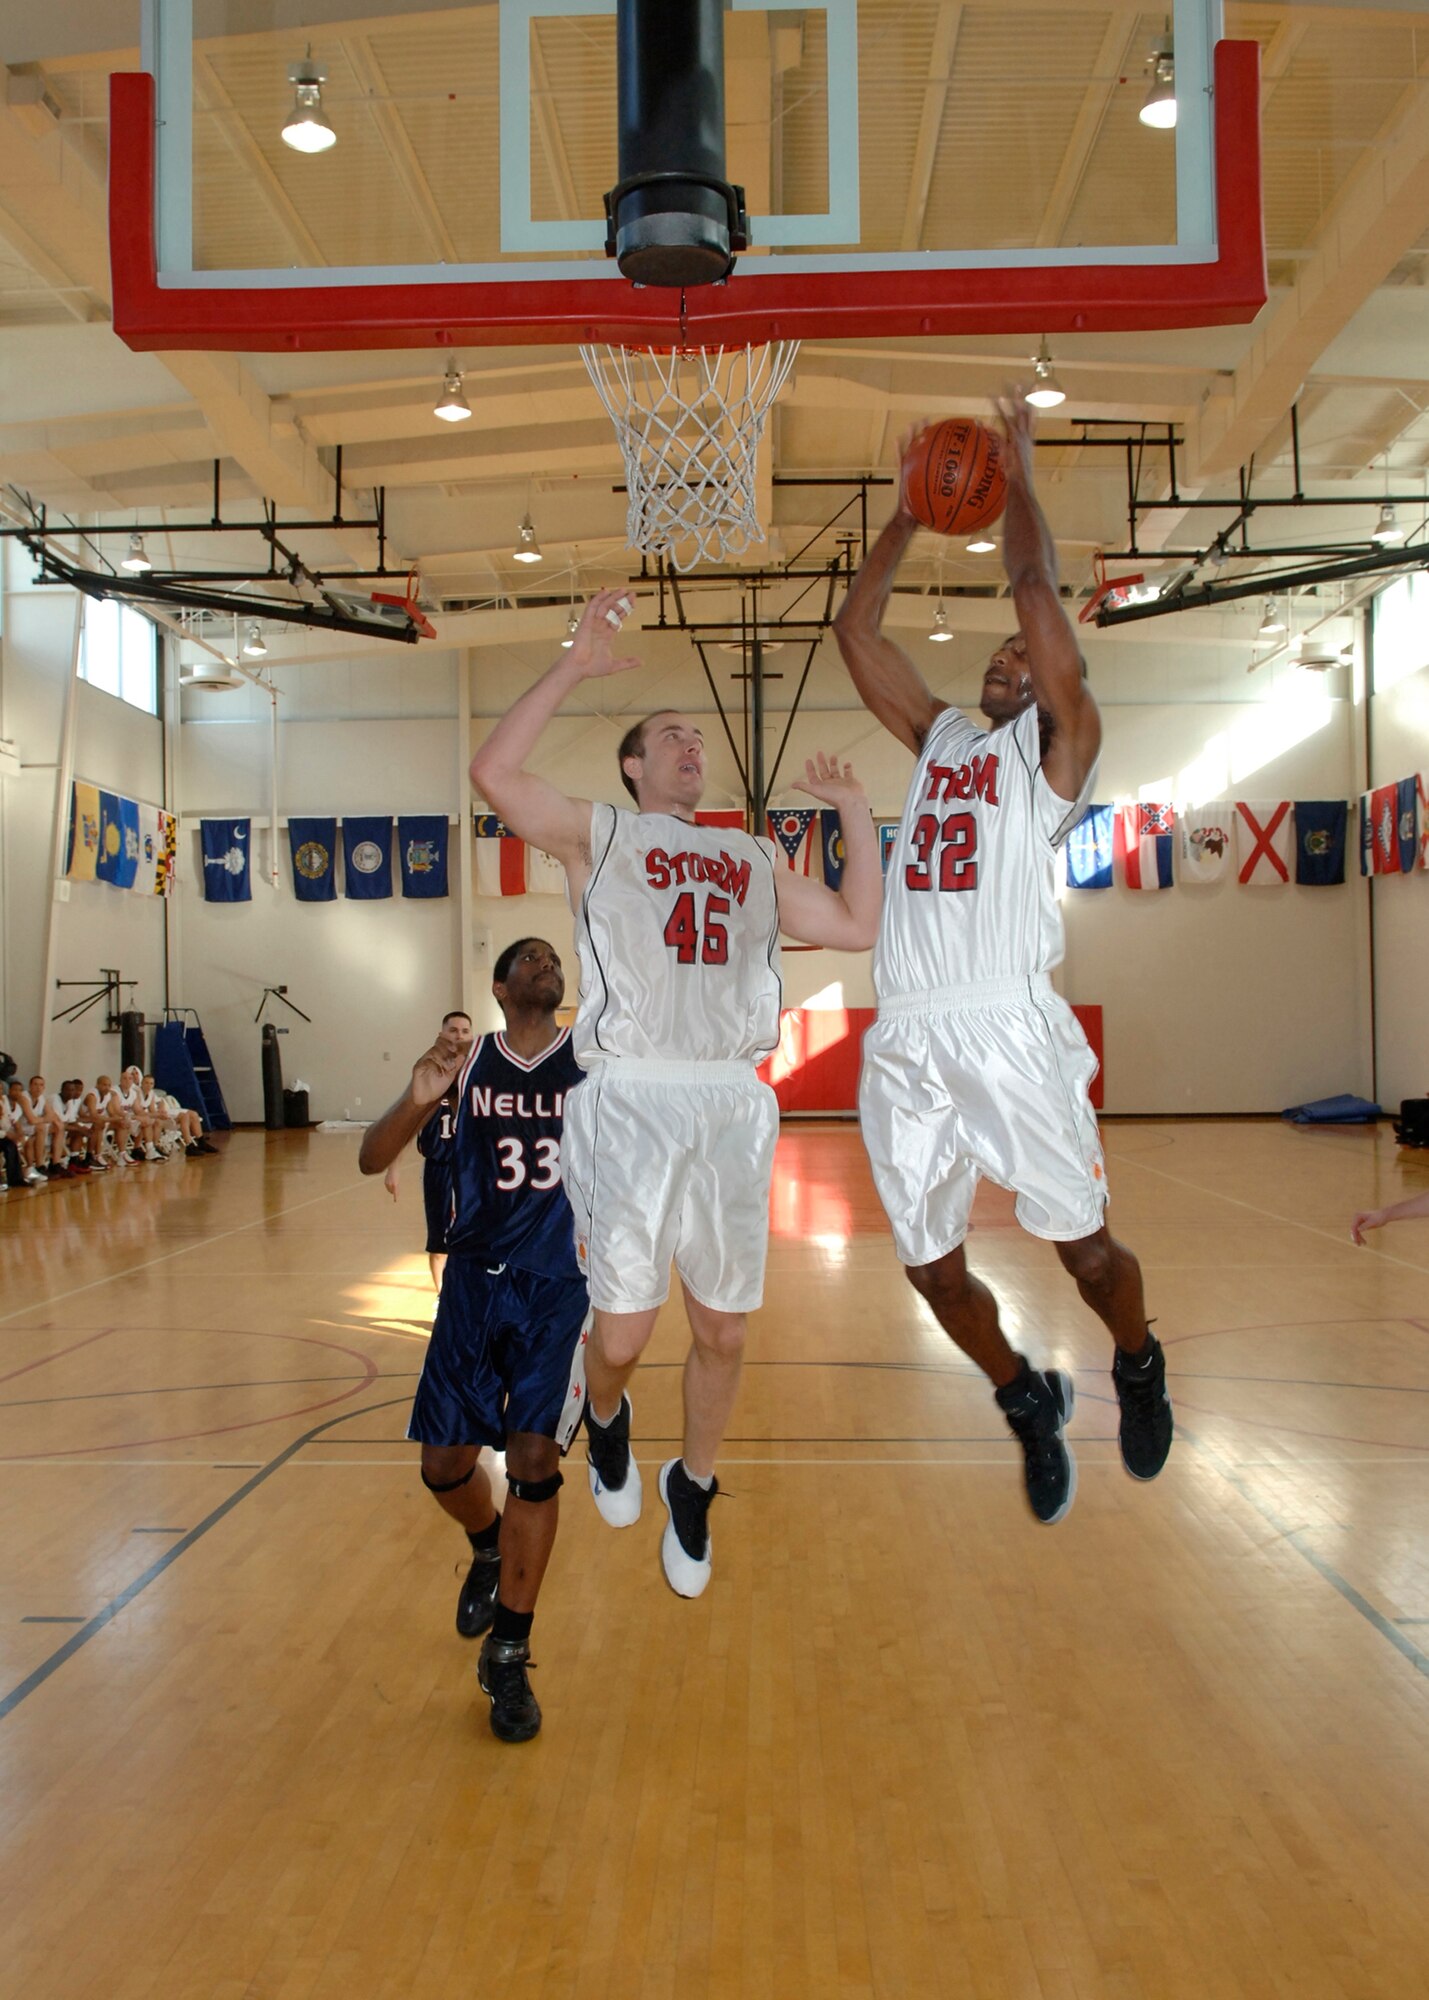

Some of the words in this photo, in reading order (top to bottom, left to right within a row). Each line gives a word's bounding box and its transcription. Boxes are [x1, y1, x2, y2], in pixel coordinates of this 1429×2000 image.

[645, 847, 753, 908] STORM
[905, 812, 978, 891] 32
[664, 892, 730, 965] 45
[471, 1085, 573, 1118] NELLI
[496, 1137, 562, 1192] 33
